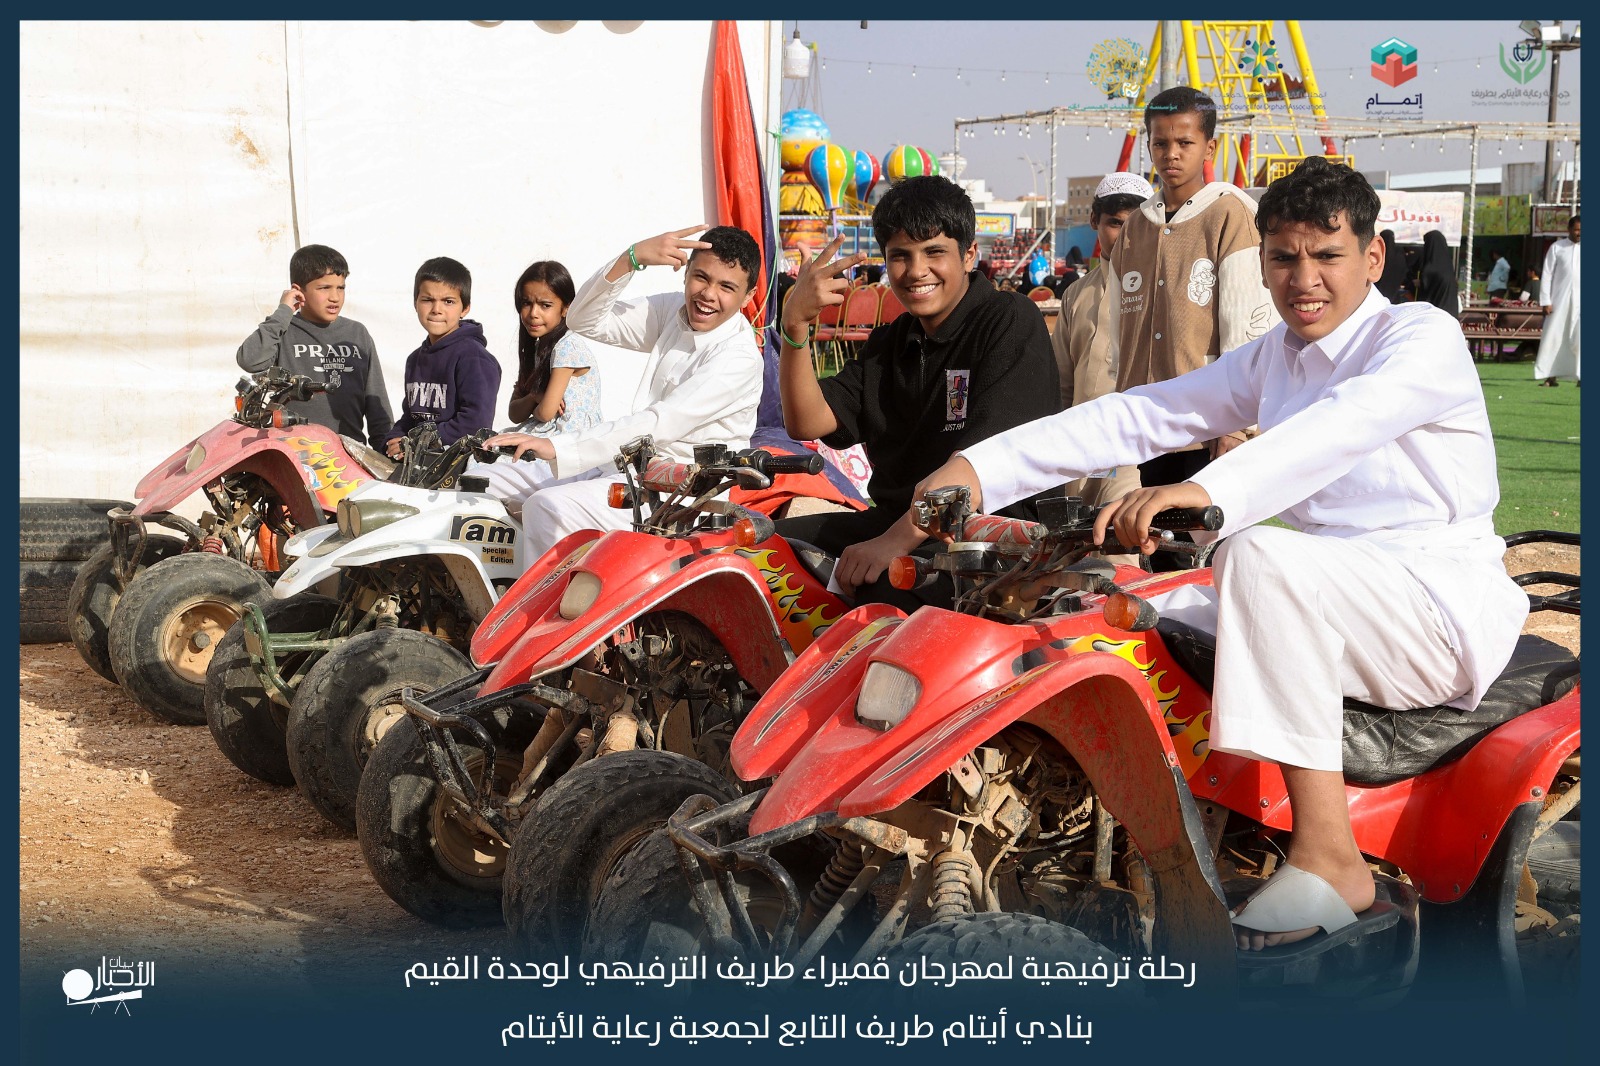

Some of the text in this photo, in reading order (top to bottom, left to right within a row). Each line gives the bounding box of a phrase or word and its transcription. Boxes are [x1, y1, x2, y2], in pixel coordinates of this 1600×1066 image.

[1377, 209, 1440, 225] شباك
[293, 344, 362, 360] PRADA
[450, 515, 516, 544] ram
[482, 547, 507, 555] Special
[490, 556, 514, 564] Edition
